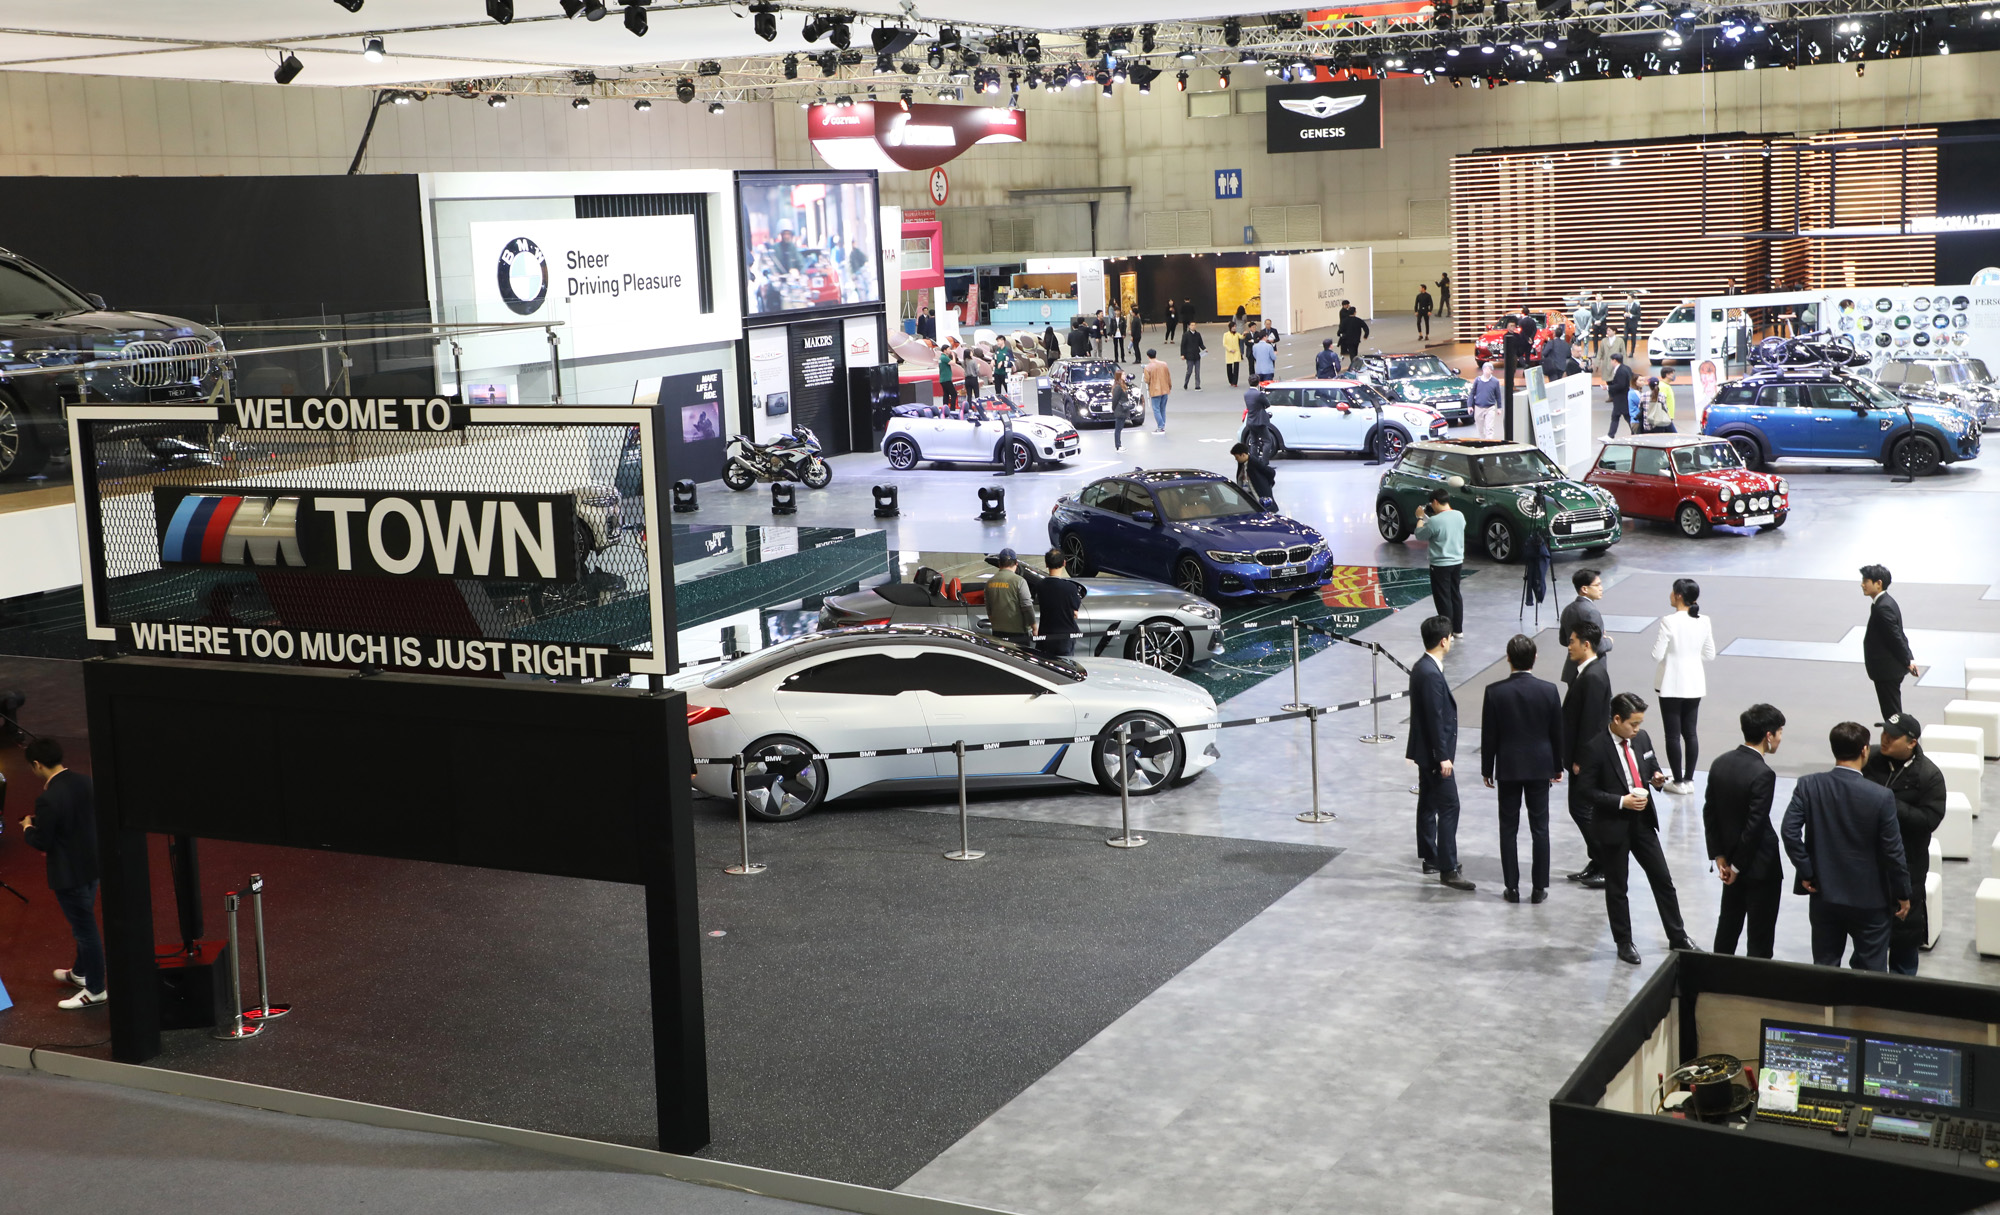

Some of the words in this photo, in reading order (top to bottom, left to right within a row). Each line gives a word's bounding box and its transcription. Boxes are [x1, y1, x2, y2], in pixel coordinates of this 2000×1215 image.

[1300, 127, 1345, 139] GENESIS
[566, 250, 609, 270] Sheer
[567, 276, 619, 297] Driving
[623, 273, 682, 292] Pleasure
[804, 335, 833, 349] MAKERS
[701, 373, 718, 383] MAKE
[696, 383, 708, 392] LIFE
[707, 382, 713, 391] A
[235, 398, 399, 430] WELCOME
[403, 398, 452, 431] TO
[314, 497, 557, 579] TOWN
[130, 621, 231, 655] WHERE
[233, 627, 295, 660] TOO
[300, 631, 388, 665] MUCH
[394, 636, 422, 667] IS
[427, 639, 505, 672] JUST
[511, 643, 609, 678] RIGHT
[1325, 704, 1339, 713] BMW
[1358, 698, 1372, 707] BMW
[1159, 728, 1175, 736] BMW
[1207, 722, 1222, 730] BMW
[1255, 716, 1270, 724] BMW
[983, 742, 1001, 750] BMW
[1074, 735, 1091, 743] BMW
[812, 752, 830, 760] BMW
[859, 750, 877, 758] BMW
